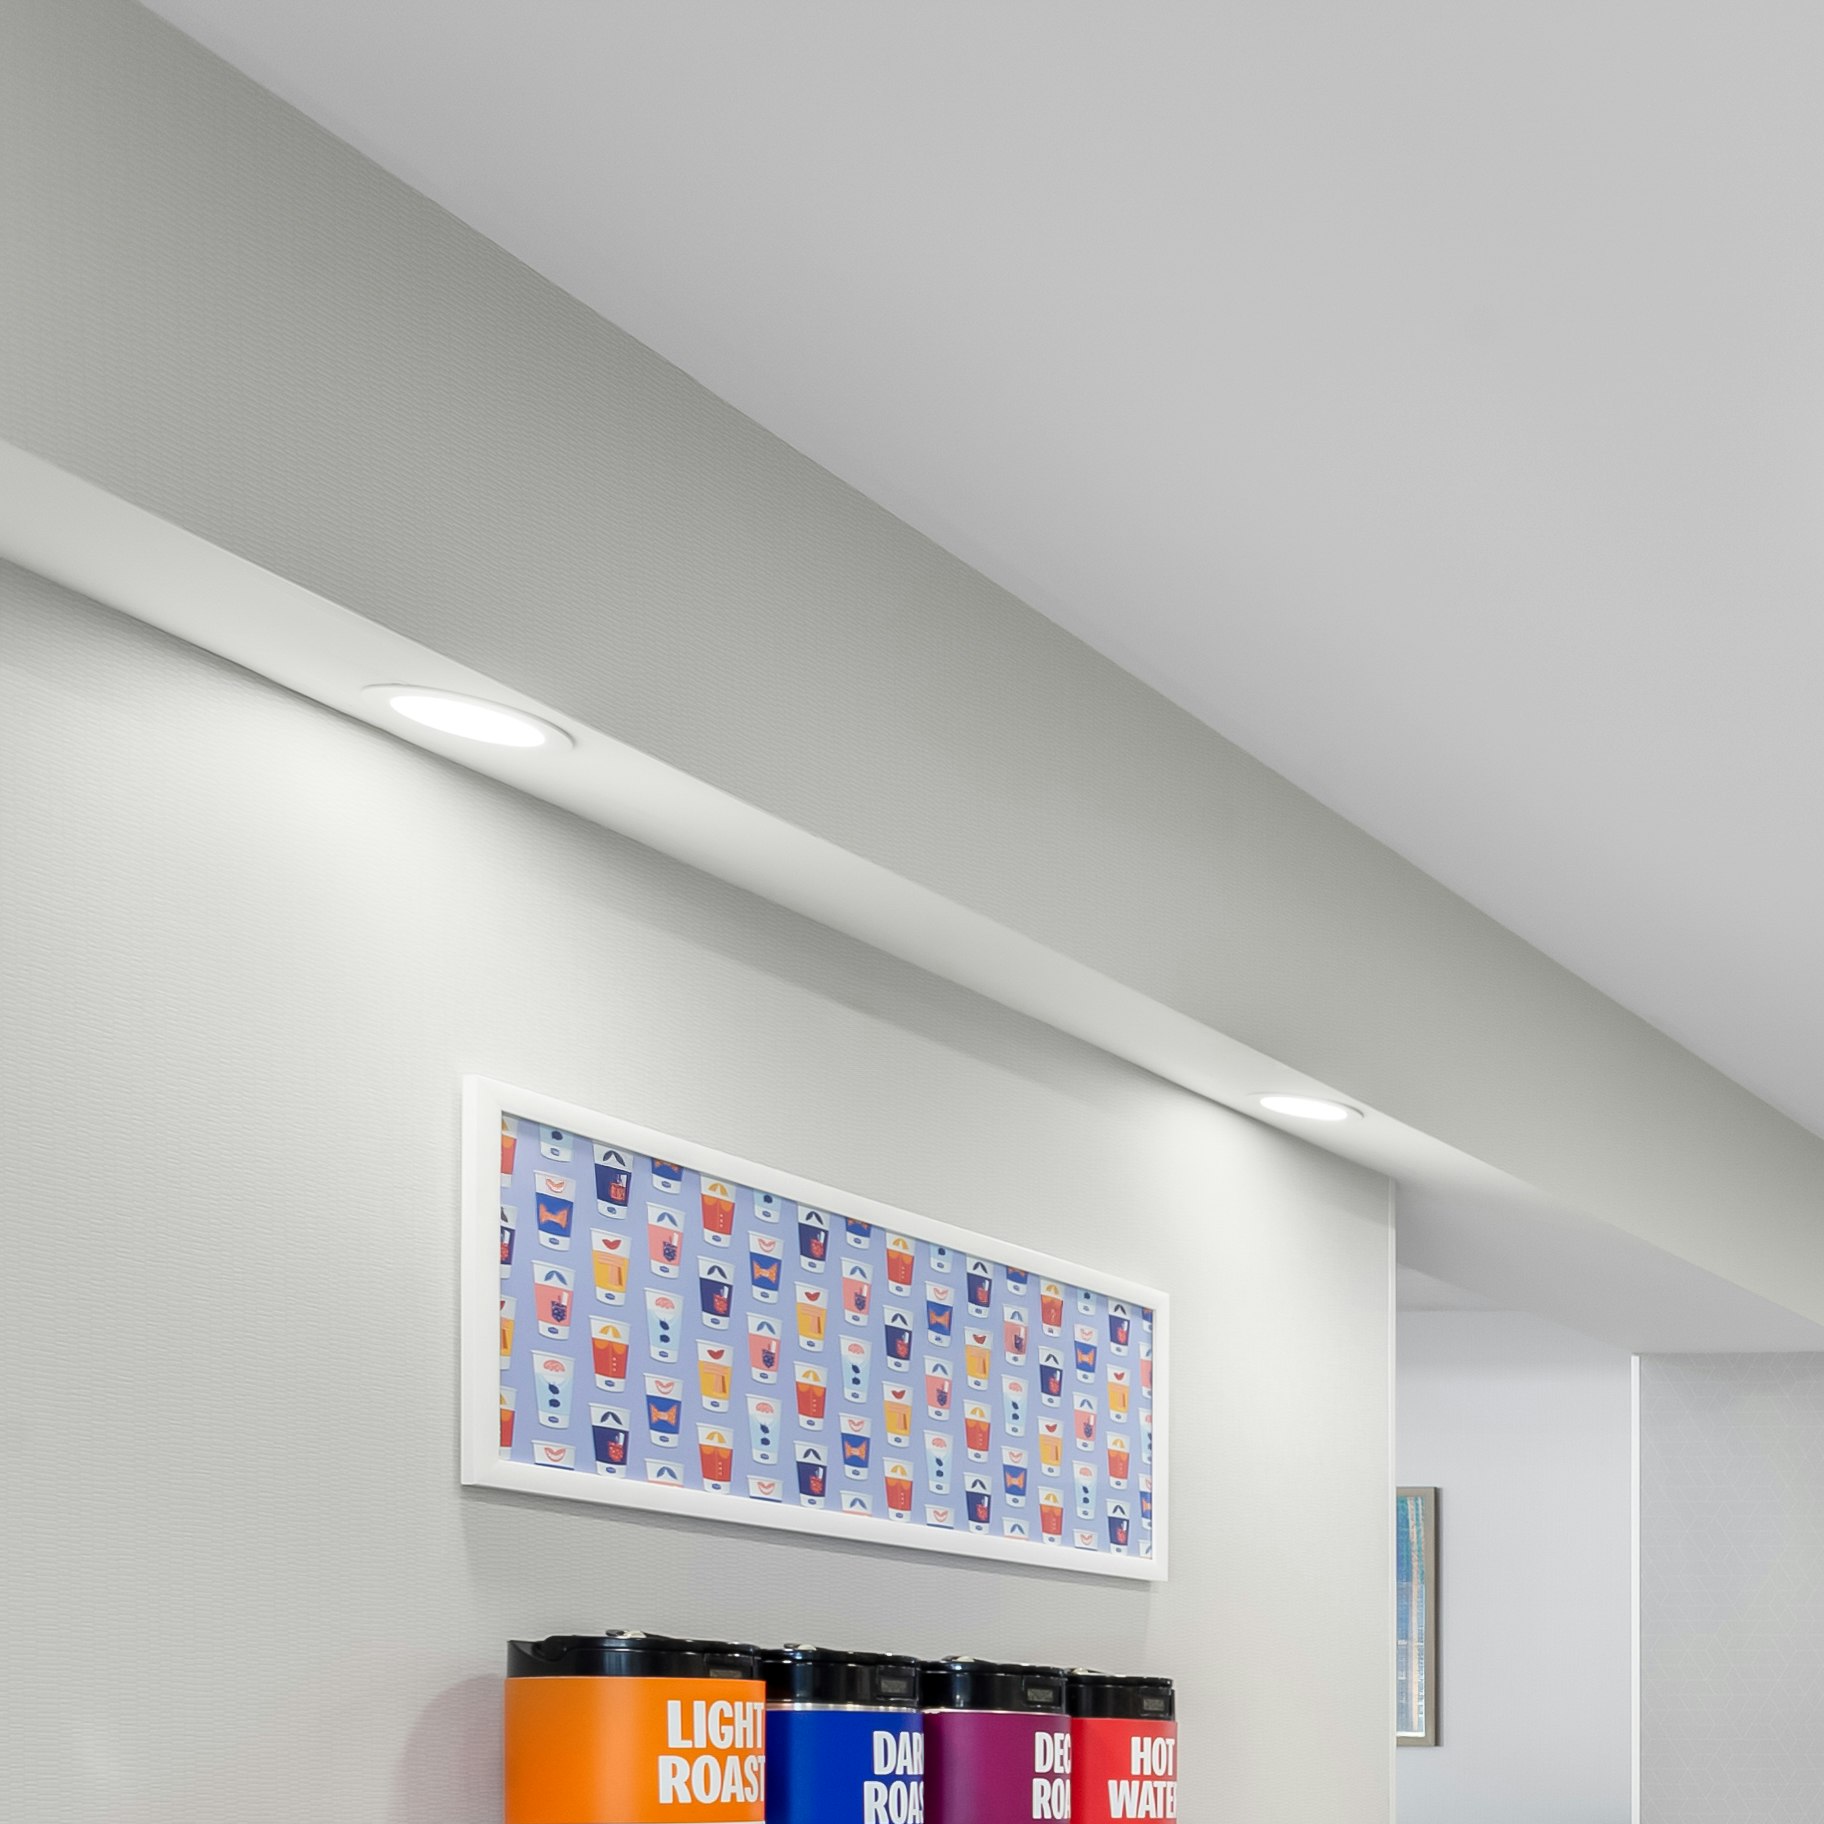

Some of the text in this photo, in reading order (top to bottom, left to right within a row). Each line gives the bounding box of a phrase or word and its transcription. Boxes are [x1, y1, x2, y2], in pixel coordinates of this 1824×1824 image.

[667, 1700, 765, 1749] LIGHT
[872, 1730, 924, 1775] DAR
[1130, 1736, 1175, 1776] HOT
[658, 1754, 766, 1804] ROAST
[1107, 1779, 1177, 1818] WATE
